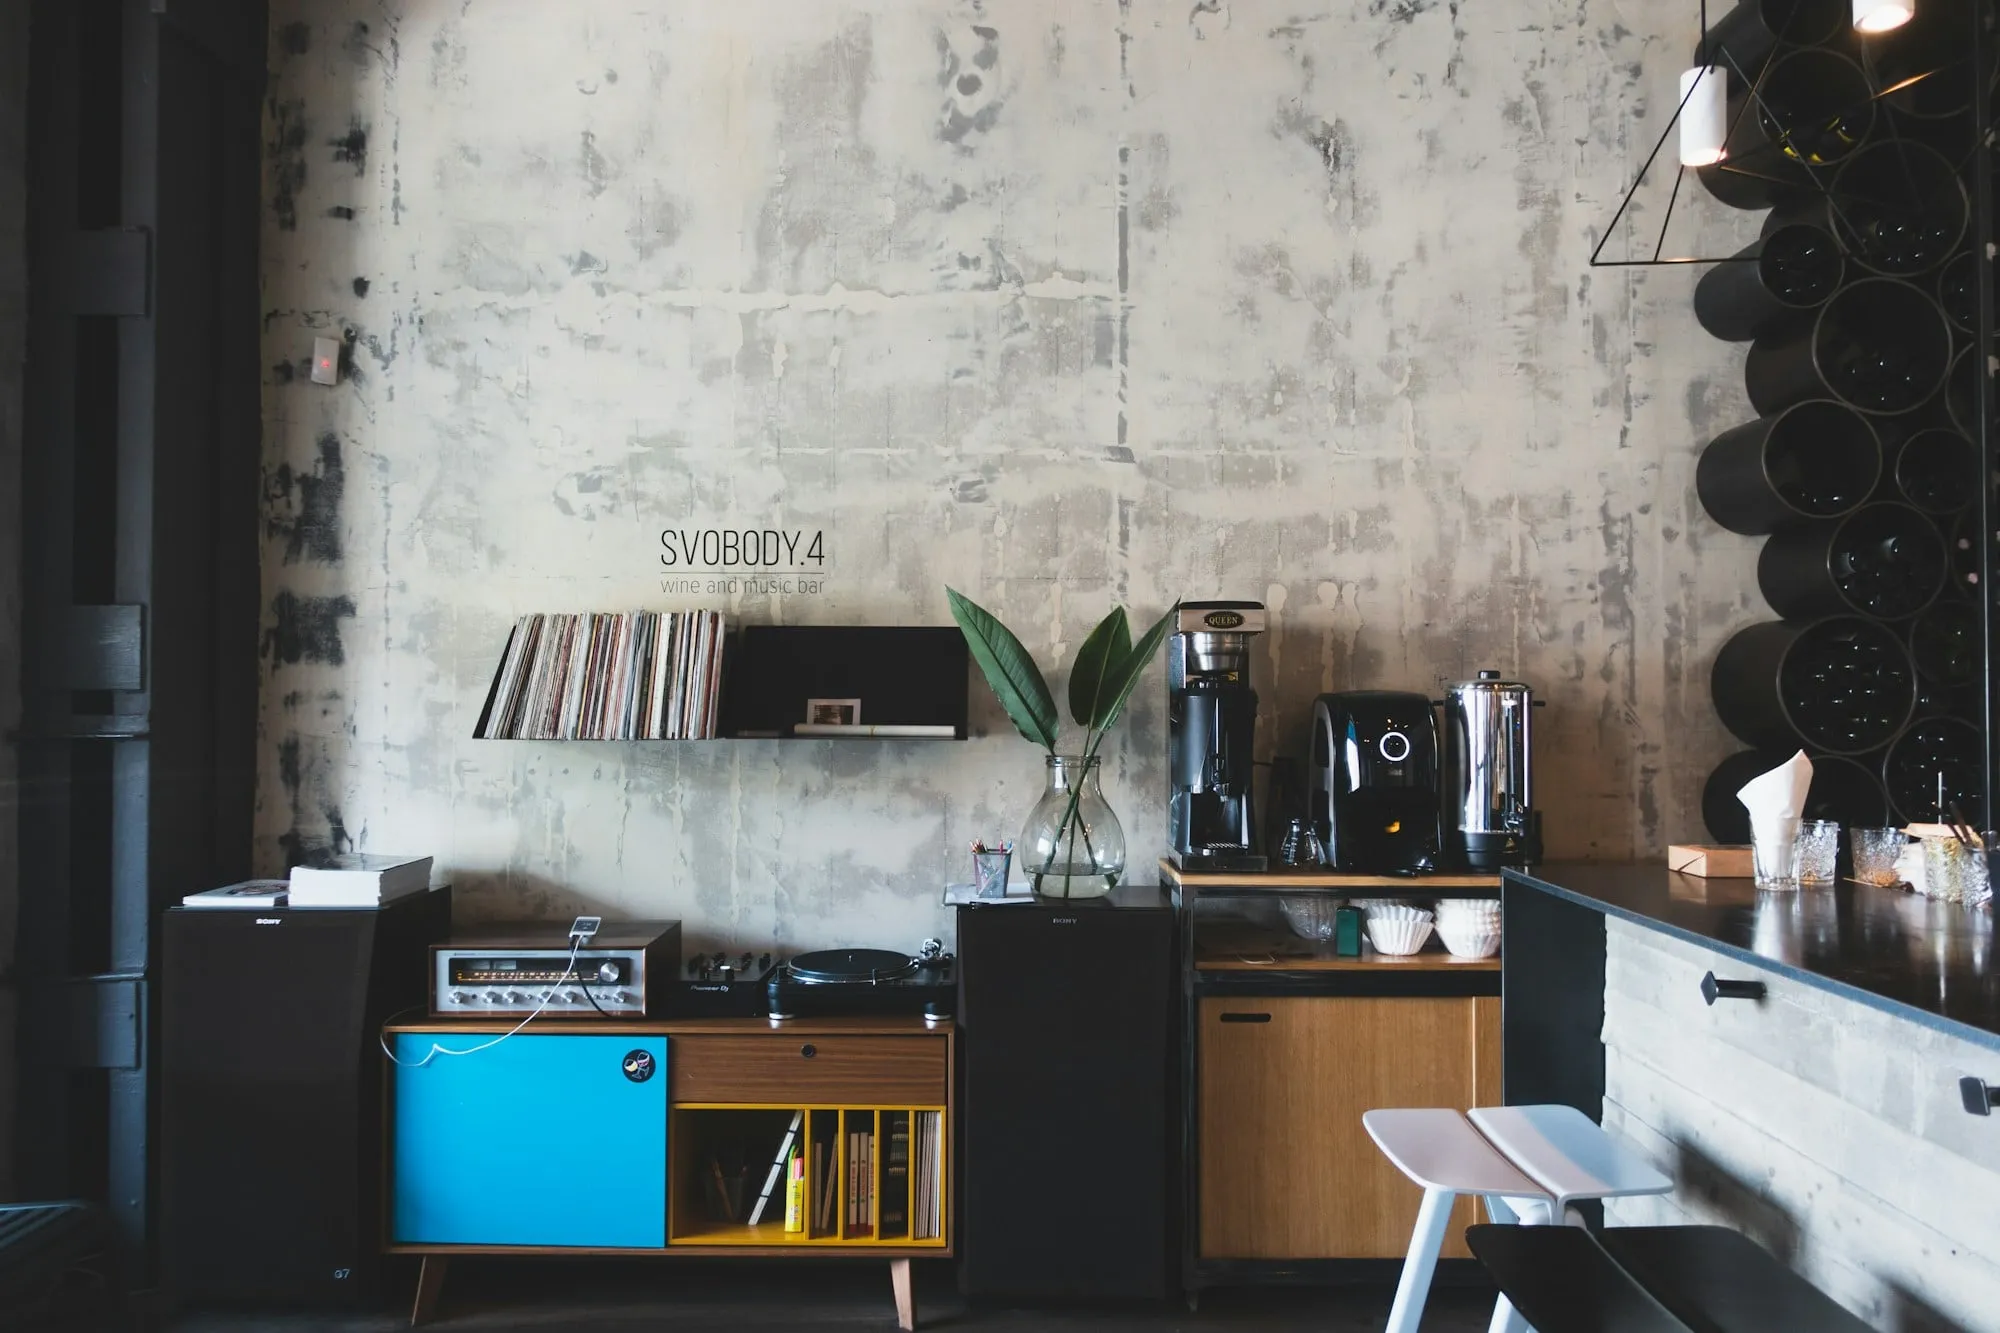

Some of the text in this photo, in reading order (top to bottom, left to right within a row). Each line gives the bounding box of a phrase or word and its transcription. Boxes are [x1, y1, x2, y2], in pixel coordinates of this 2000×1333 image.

[661, 529, 825, 566] SVOBODY.4
[661, 577, 824, 594] wine and music bar
[1209, 616, 1238, 625] QUEEN
